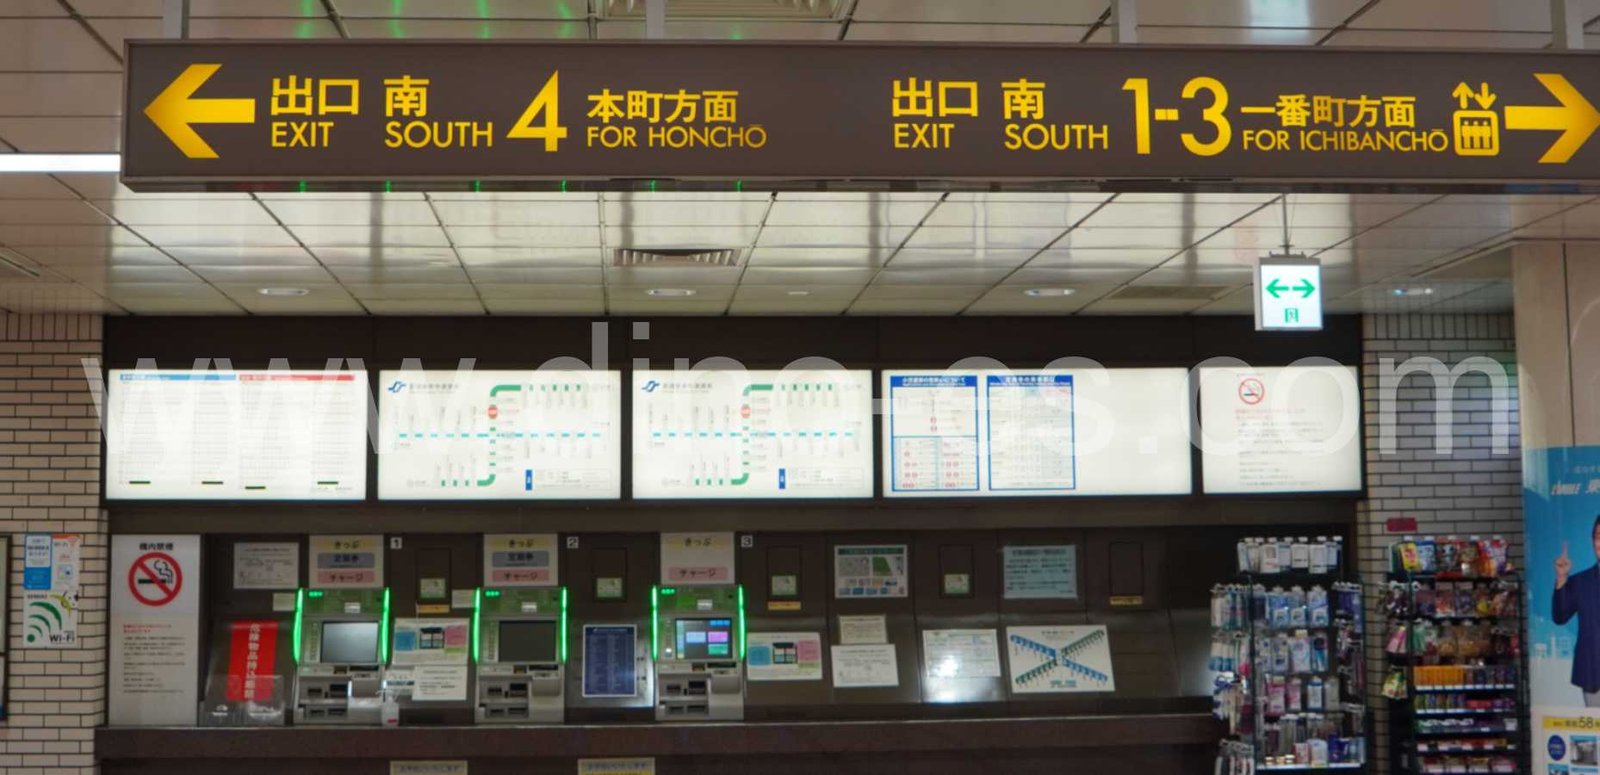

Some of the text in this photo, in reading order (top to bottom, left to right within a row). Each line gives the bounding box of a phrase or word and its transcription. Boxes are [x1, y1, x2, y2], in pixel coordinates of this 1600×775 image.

[271, 75, 430, 117] 出口 南
[506, 70, 567, 152] 4
[586, 89, 739, 123] 本町方面
[892, 77, 1046, 119] 出口 南
[1240, 94, 1417, 128] 一番町方面
[1122, 77, 1232, 156] 1-3
[271, 120, 494, 149] EXIT SOUTH
[586, 125, 638, 149] FOR
[894, 123, 1109, 151] EXIT SOUTH
[1242, 128, 1291, 152] FOR
